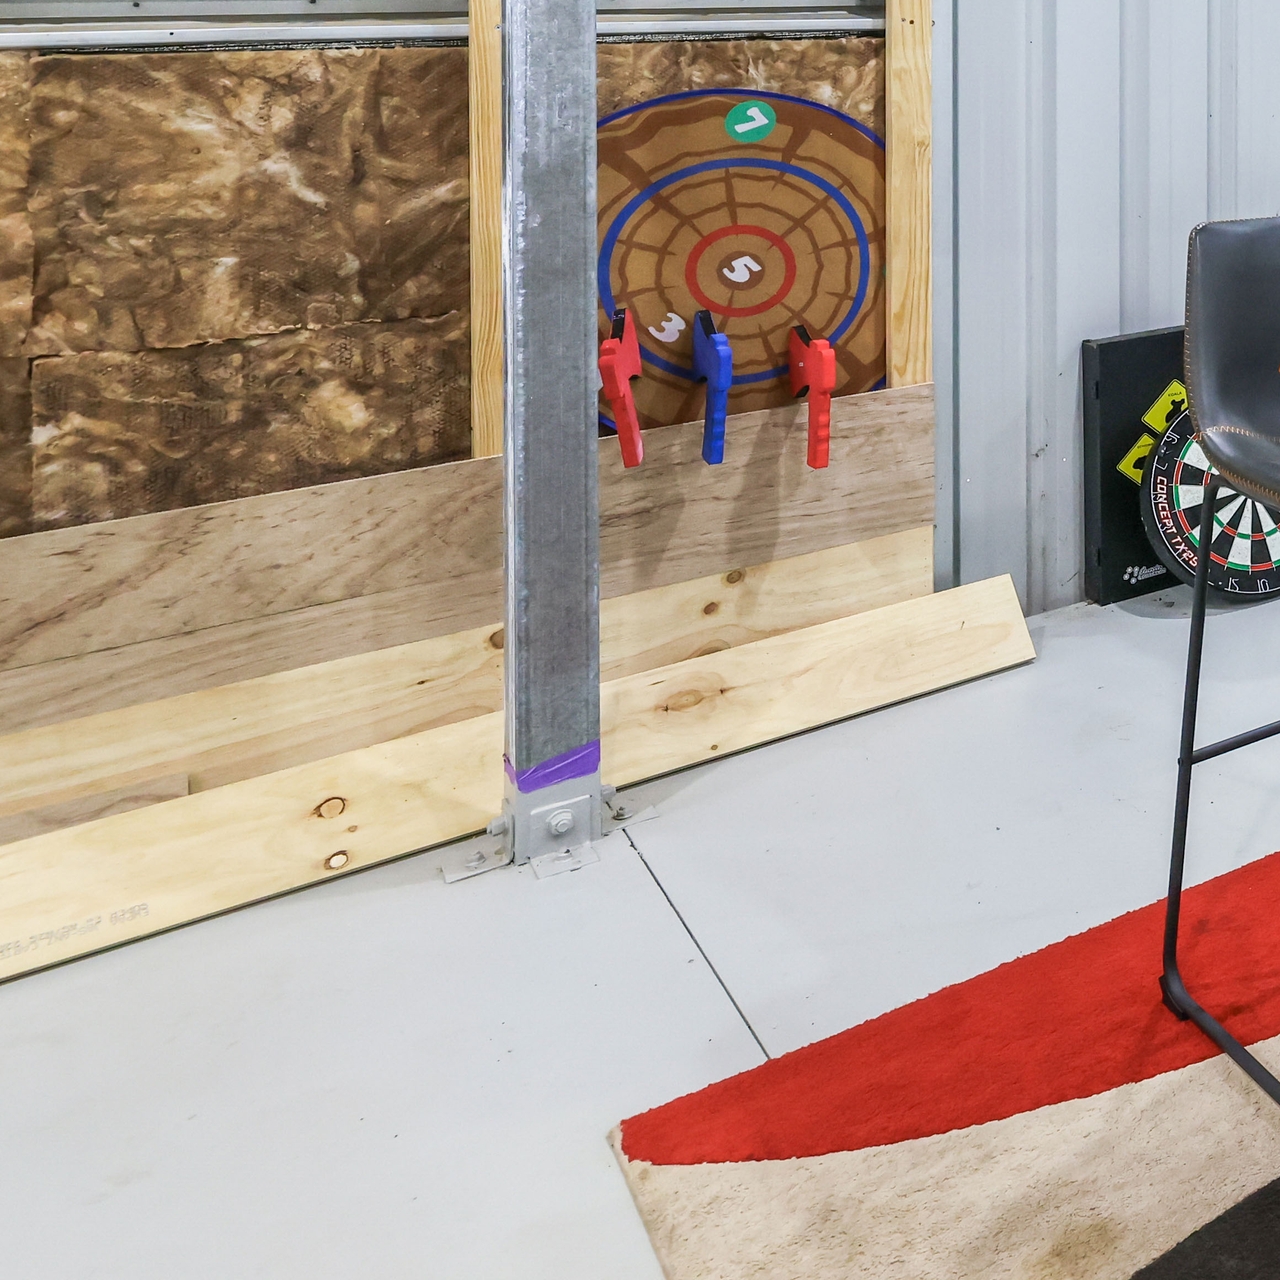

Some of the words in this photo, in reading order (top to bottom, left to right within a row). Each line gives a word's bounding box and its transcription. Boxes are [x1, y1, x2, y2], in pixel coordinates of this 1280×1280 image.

[722, 254, 763, 283] 5
[647, 311, 687, 344] 3
[1156, 476, 1178, 534] CONCEPT
